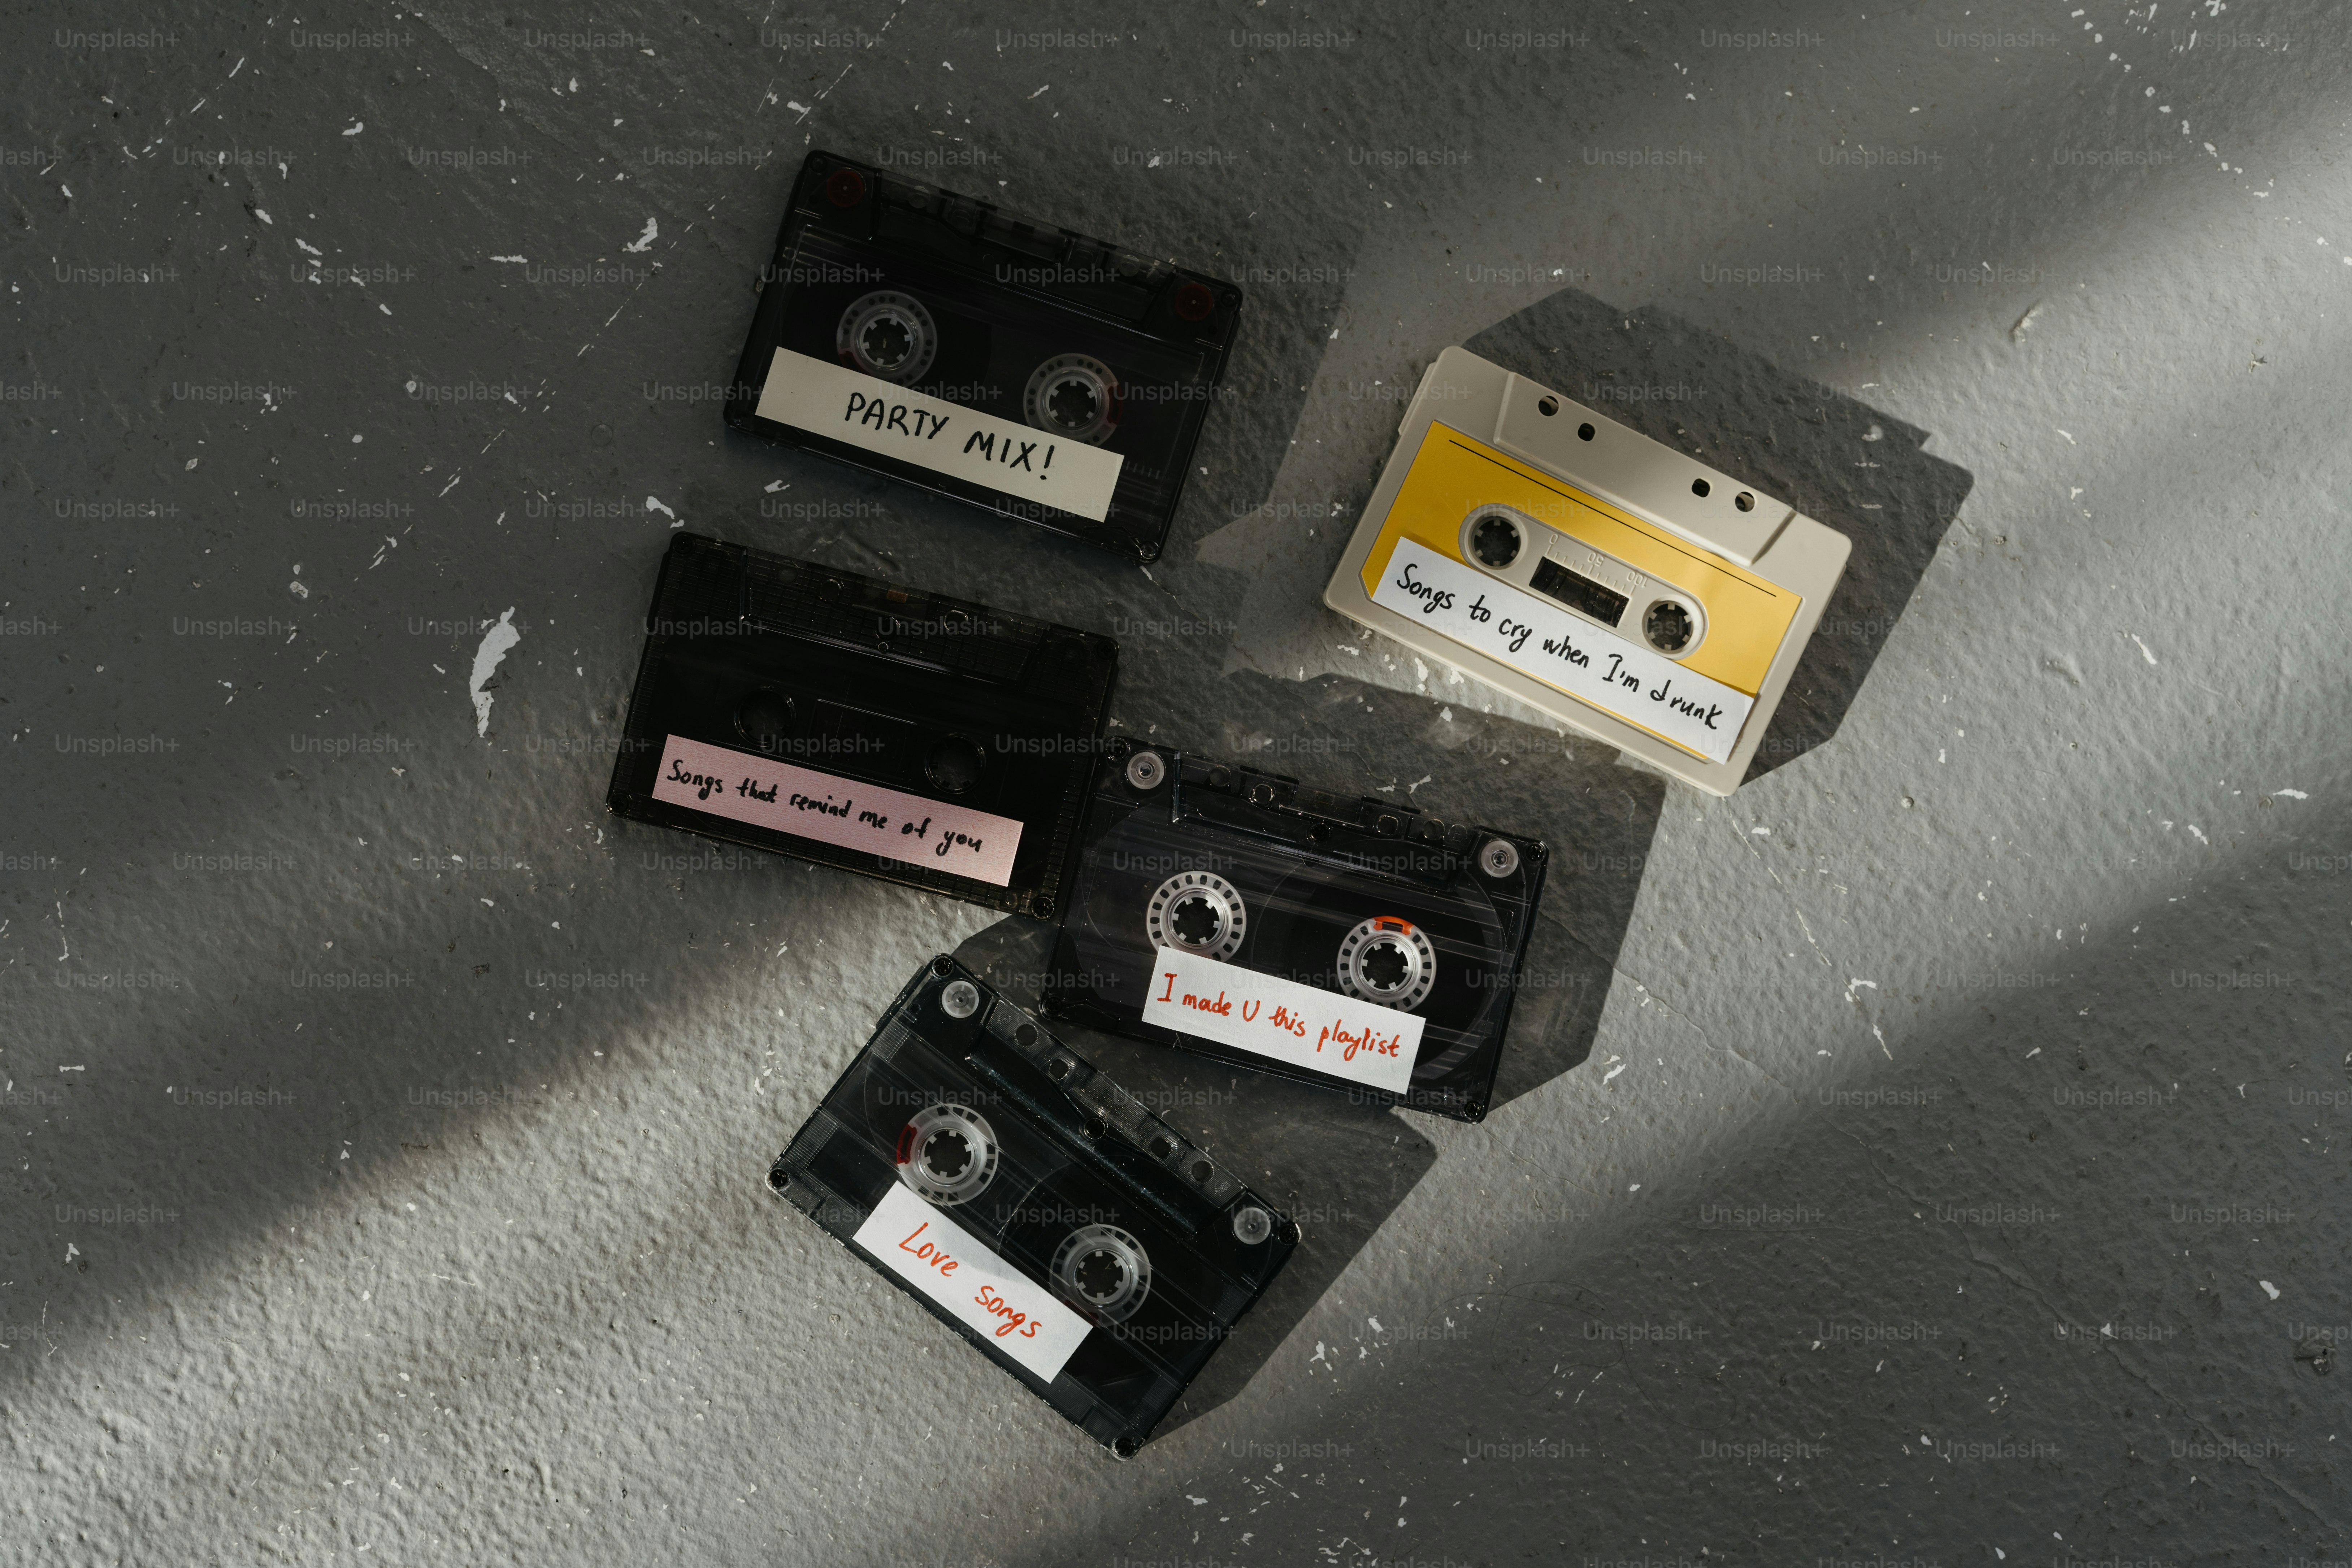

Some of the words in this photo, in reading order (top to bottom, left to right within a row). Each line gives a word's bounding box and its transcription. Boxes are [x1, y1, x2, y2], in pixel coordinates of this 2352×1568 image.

[845, 392, 949, 439] PARTY
[964, 431, 1054, 480] MIX!
[1587, 552, 1604, 567] 50
[1626, 571, 1648, 588] 100
[1397, 564, 1455, 613] Songs
[1469, 595, 1490, 622] to
[1499, 619, 1532, 652] cry
[1543, 635, 1589, 668] when
[1602, 654, 1639, 692] I'm
[1650, 680, 1722, 729] drunk
[667, 760, 722, 800] Songs
[735, 778, 778, 803] that
[790, 794, 852, 817] remind
[859, 811, 888, 829] me
[901, 817, 931, 839] of
[936, 831, 982, 856] you
[1158, 973, 1177, 1002] I
[1183, 991, 1231, 1016] made
[1243, 1000, 1260, 1021] U
[1269, 1006, 1305, 1037] this
[1317, 1020, 1400, 1061] playlist
[899, 1222, 958, 1276] Love
[975, 1286, 1041, 1337] songs
